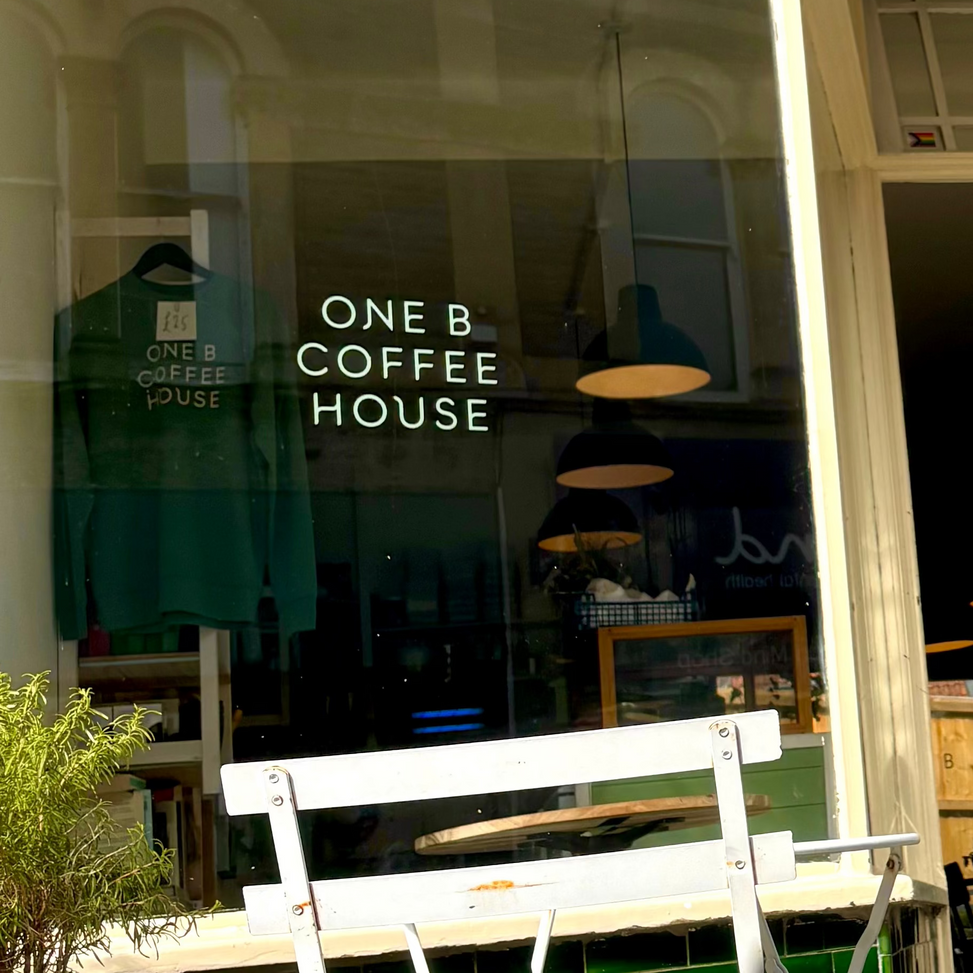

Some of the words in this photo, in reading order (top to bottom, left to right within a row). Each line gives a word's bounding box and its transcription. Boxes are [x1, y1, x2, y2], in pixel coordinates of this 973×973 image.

[321, 295, 427, 335] ONE
[448, 303, 472, 337] B
[146, 342, 194, 363] ONE
[204, 344, 216, 362] B
[296, 342, 498, 386] COFFEE
[136, 364, 226, 388] COFFEE
[146, 387, 221, 411] HOUSE
[313, 392, 490, 432] HOUSE
[943, 753, 954, 769] B
